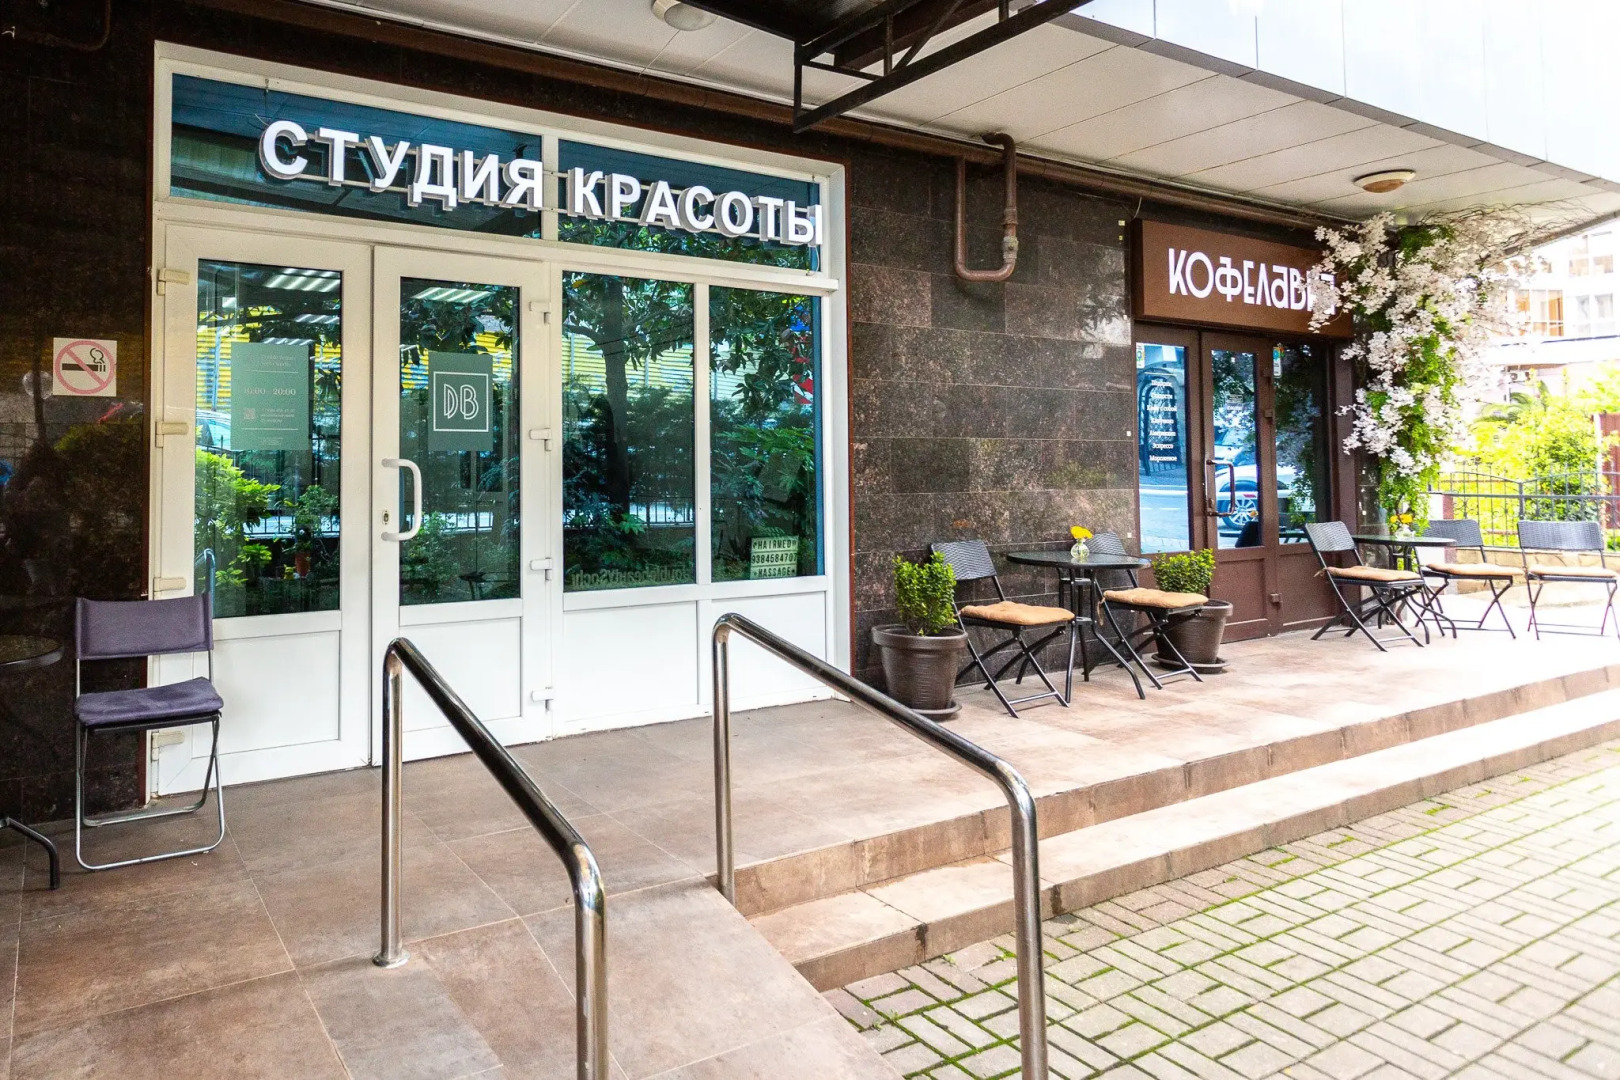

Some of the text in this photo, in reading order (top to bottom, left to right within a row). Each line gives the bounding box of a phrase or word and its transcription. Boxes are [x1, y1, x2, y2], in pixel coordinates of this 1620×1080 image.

[260, 120, 823, 246] СТУДИЯ КРАСОТЫ
[272, 387, 297, 396] 20:00
[443, 383, 480, 420] DB
[757, 539, 792, 550] HAIRMED
[751, 552, 798, 564] 9384584707
[758, 566, 791, 578] MASSAGE
